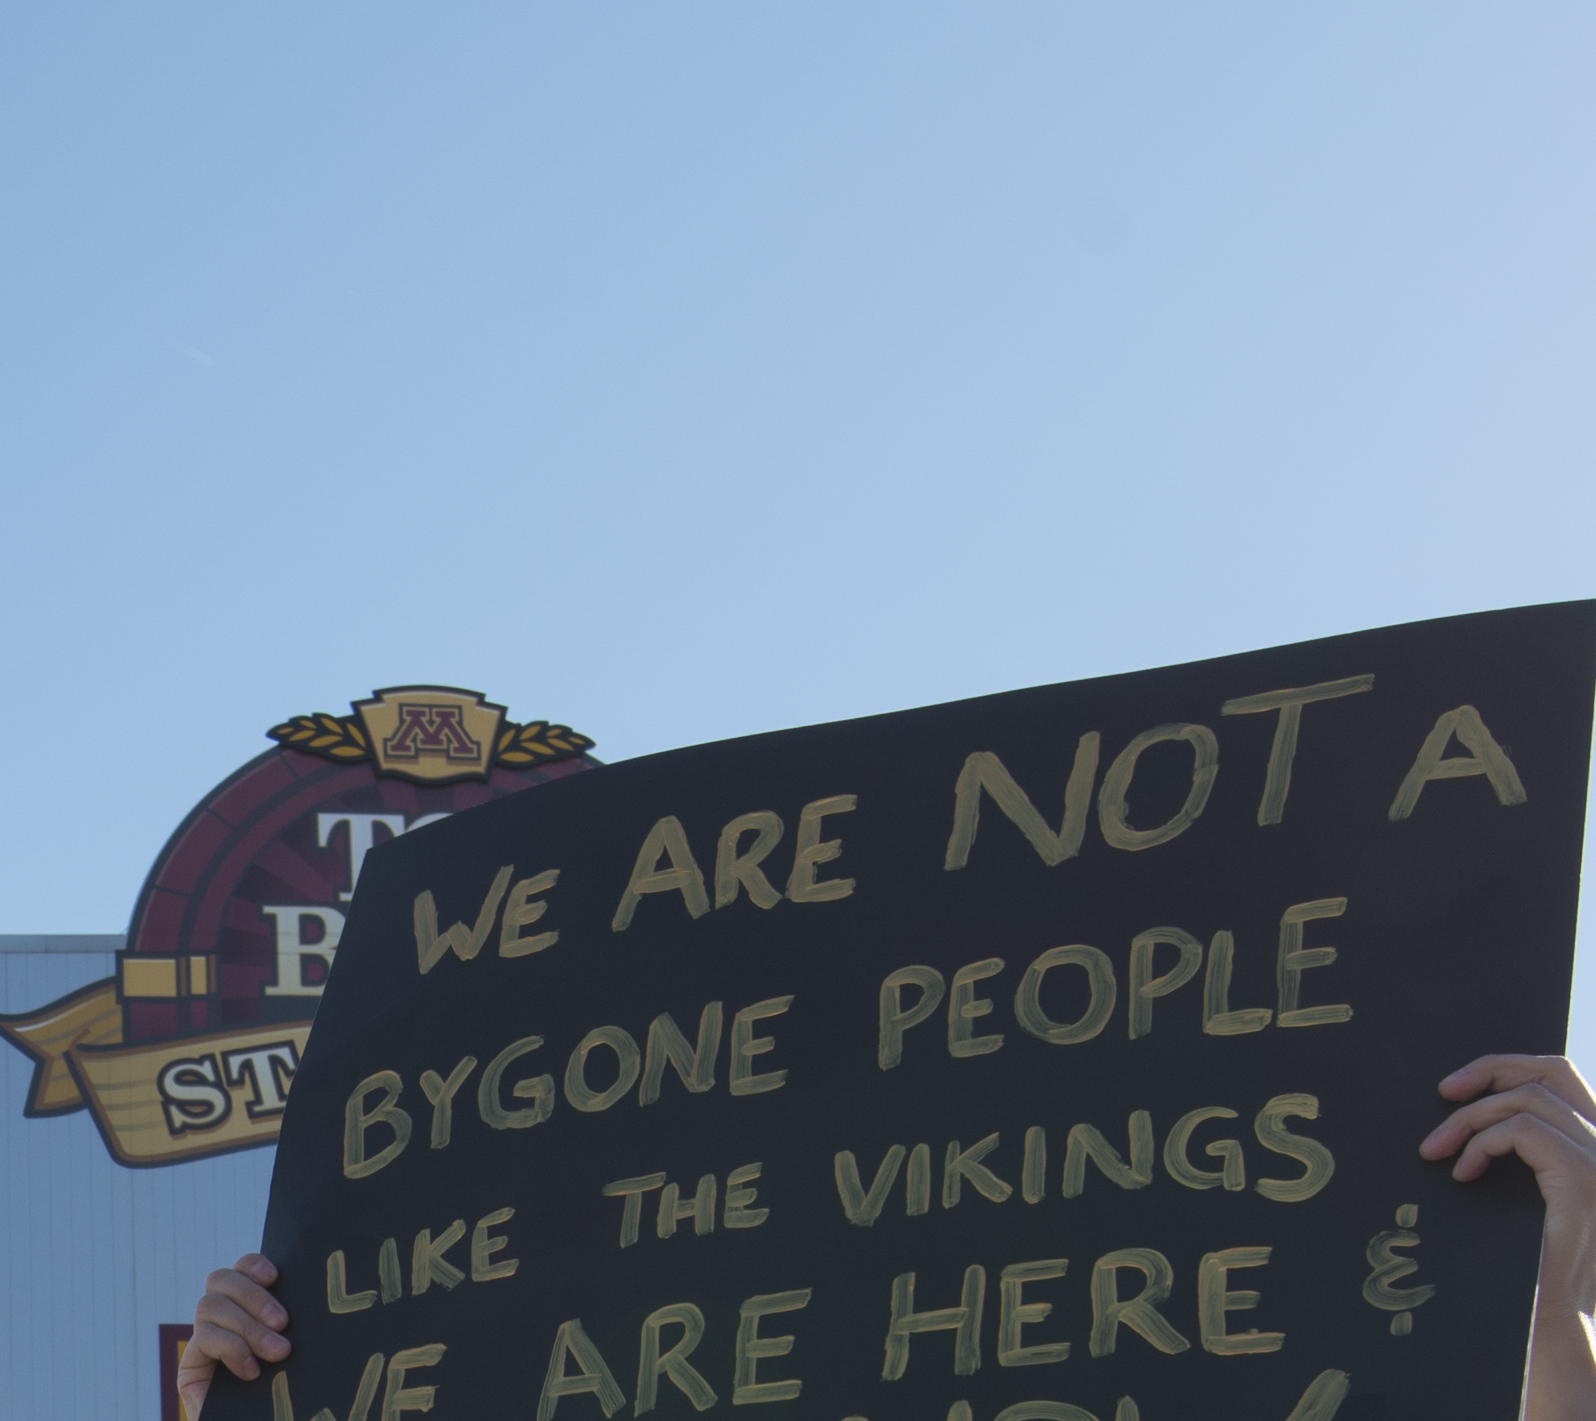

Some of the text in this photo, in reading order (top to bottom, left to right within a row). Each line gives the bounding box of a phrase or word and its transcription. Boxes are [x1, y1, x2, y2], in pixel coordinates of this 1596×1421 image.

[414, 674, 1526, 973] WE ARE NOT A
[343, 897, 1352, 1180] BYGONE PEOPLE
[327, 1093, 1334, 1313] LIKE THE VIKINGS
[882, 1247, 1285, 1382] HERE
